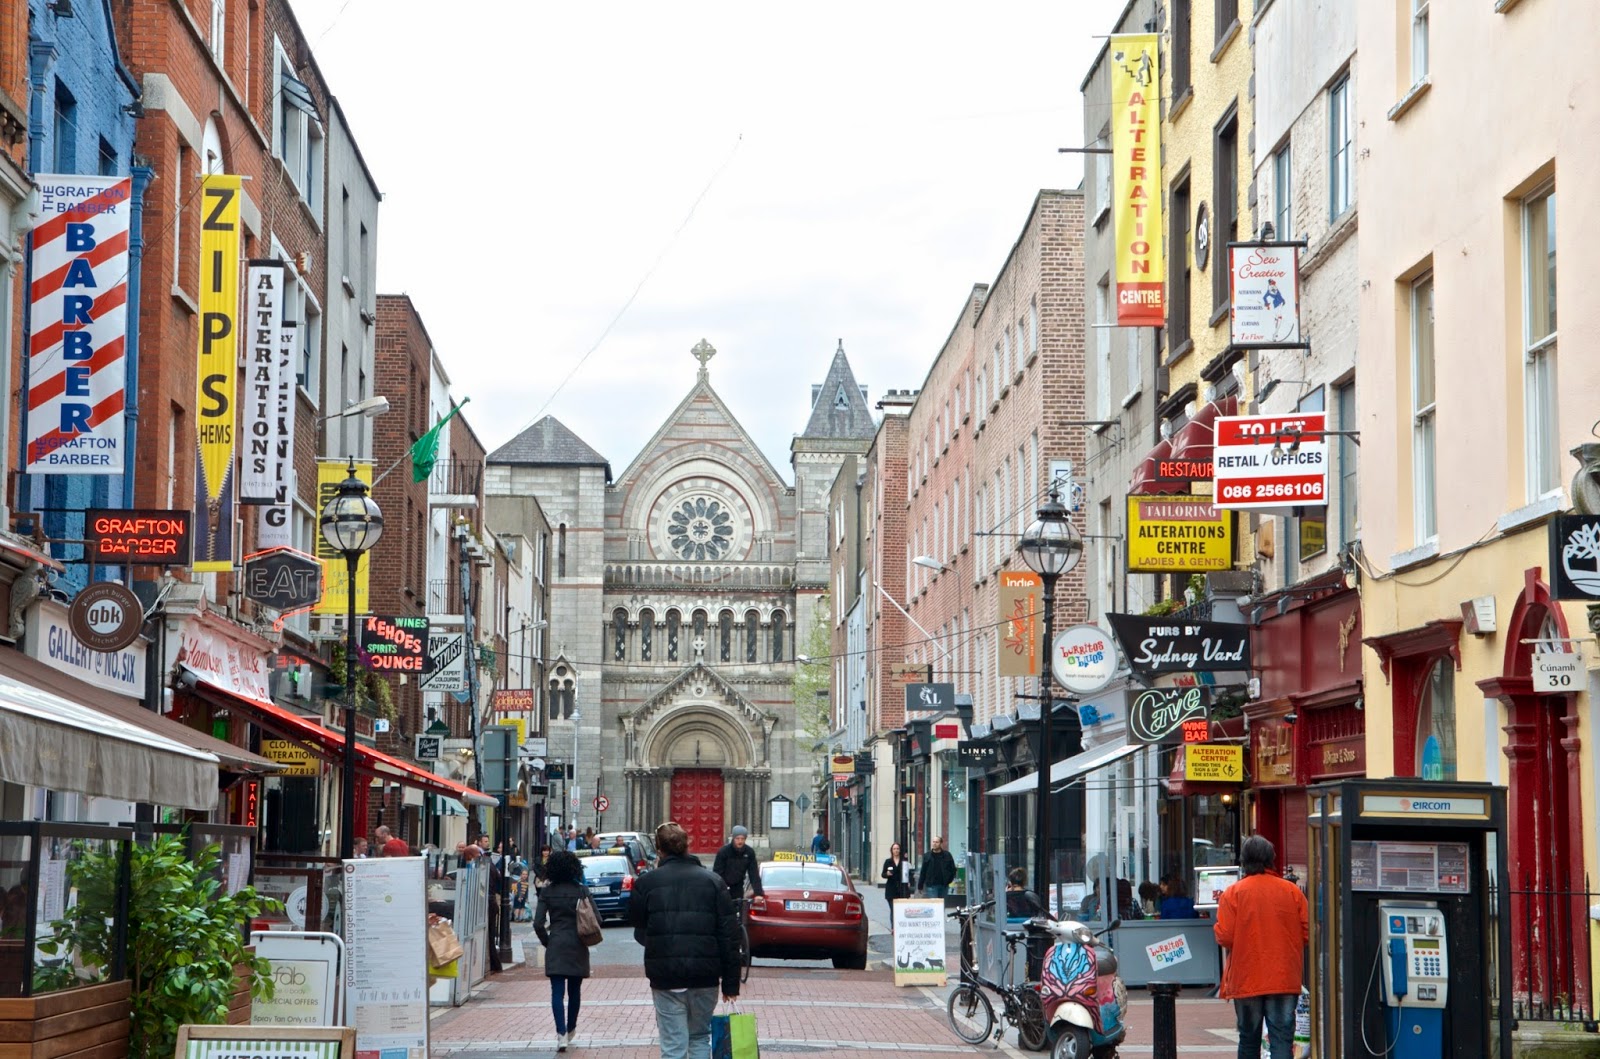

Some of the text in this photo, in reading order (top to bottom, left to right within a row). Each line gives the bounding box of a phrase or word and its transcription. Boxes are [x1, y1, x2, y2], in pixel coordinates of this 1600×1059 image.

[1128, 92, 1150, 274] ALTERATION
[42, 186, 54, 212] THE
[55, 186, 124, 198] GRAFTON
[57, 203, 116, 214] BARBER
[1248, 247, 1280, 265] Sew
[1239, 264, 1286, 279] Creative
[201, 189, 234, 417] ZIPS
[1120, 290, 1161, 304] CENTRE
[60, 222, 97, 433] BARBER
[251, 274, 273, 474] ALTERATIONS
[200, 425, 231, 444] HEMS
[1239, 423, 1265, 439] TO
[35, 437, 47, 464] THE
[48, 438, 116, 448] GRAFTON
[49, 454, 110, 465] BARBER
[1218, 455, 1259, 468] RETAIL
[1272, 452, 1322, 465] OFFICES
[1160, 462, 1215, 477] RESTAUR
[1223, 482, 1322, 498] 086 2566106
[1145, 505, 1217, 518] TAILORING
[95, 518, 184, 535] GRAFTON
[1139, 525, 1225, 538] ALTERATIONS
[100, 538, 177, 554] BARBER
[1157, 541, 1206, 554] CENTRE
[1139, 557, 1225, 566] LADIES & GENTS
[251, 565, 315, 600] EAT
[81, 588, 131, 608] gourmet burger
[89, 606, 120, 625] gbk
[395, 618, 427, 628] WINES
[367, 616, 421, 653] KEHOES
[1148, 626, 1201, 636] FURS BY
[90, 635, 119, 644] kitchen
[48, 625, 92, 670] GALLERY
[122, 653, 136, 684] SIX
[367, 644, 397, 653] SPIRITS
[1133, 638, 1245, 669] Sydney Vard
[371, 655, 423, 670] OUNGE
[1540, 663, 1576, 672] Cúnamh
[1549, 675, 1571, 686] 30
[1166, 690, 1178, 699] LA
[1130, 688, 1207, 741] Cave
[1182, 721, 1207, 730] WINE
[1184, 731, 1207, 741] BAR
[263, 751, 319, 759] ALTERATION
[796, 854, 815, 862] TAXI
[345, 876, 356, 988] gourmet burger kitchen
[273, 967, 306, 985] fab
[254, 1015, 272, 1023] Spray
[287, 1015, 302, 1023] Only
